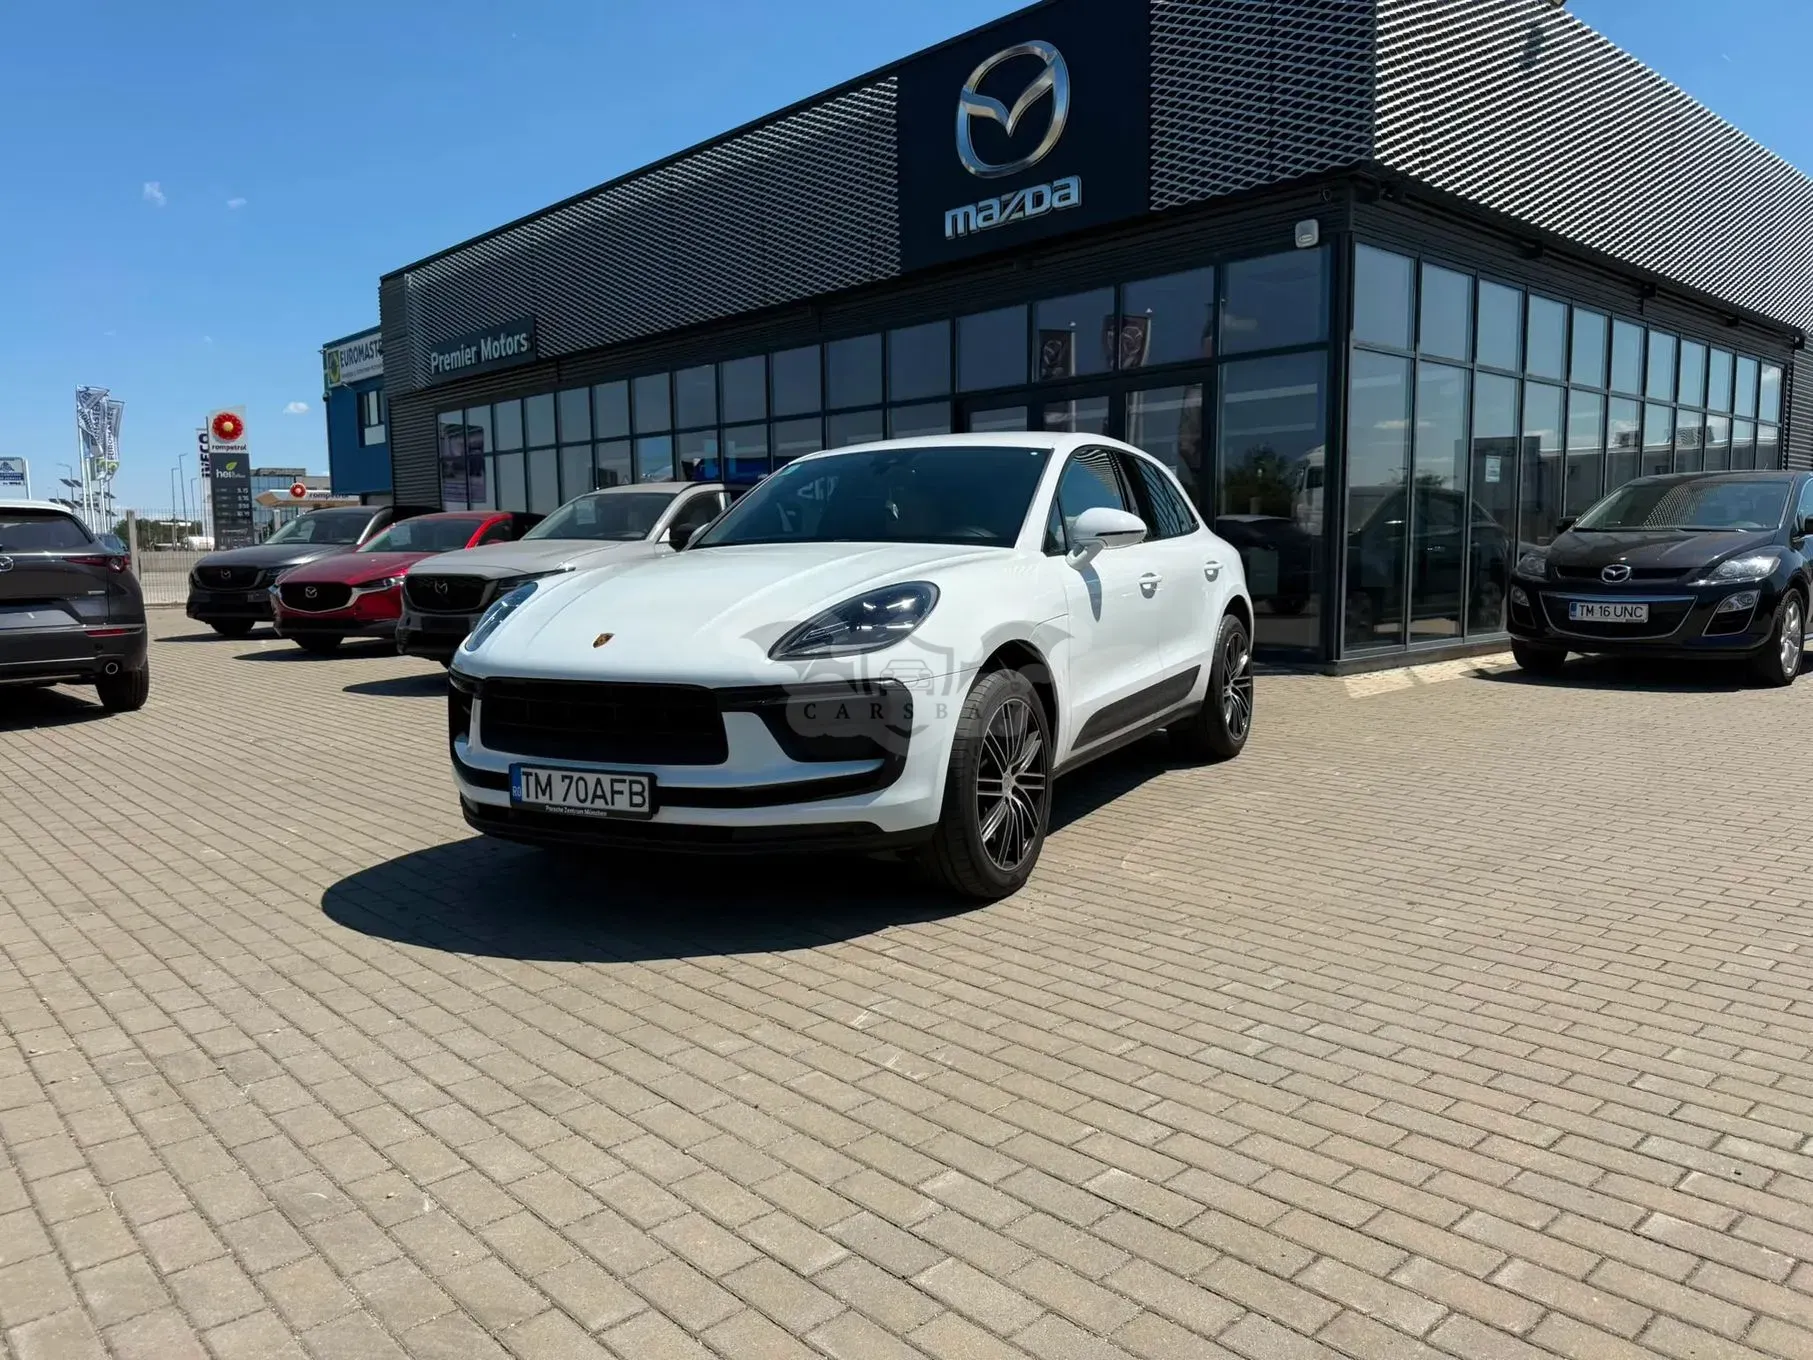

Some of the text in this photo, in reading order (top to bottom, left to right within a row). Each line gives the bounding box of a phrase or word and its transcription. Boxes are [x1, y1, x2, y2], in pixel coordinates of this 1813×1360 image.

[431, 333, 528, 374] Premier Motors
[212, 444, 246, 452] rompetrol
[1579, 604, 1594, 617] TM
[1599, 605, 1611, 617] 16
[1614, 605, 1643, 618] UNC
[522, 770, 646, 808] TM 70AFB
